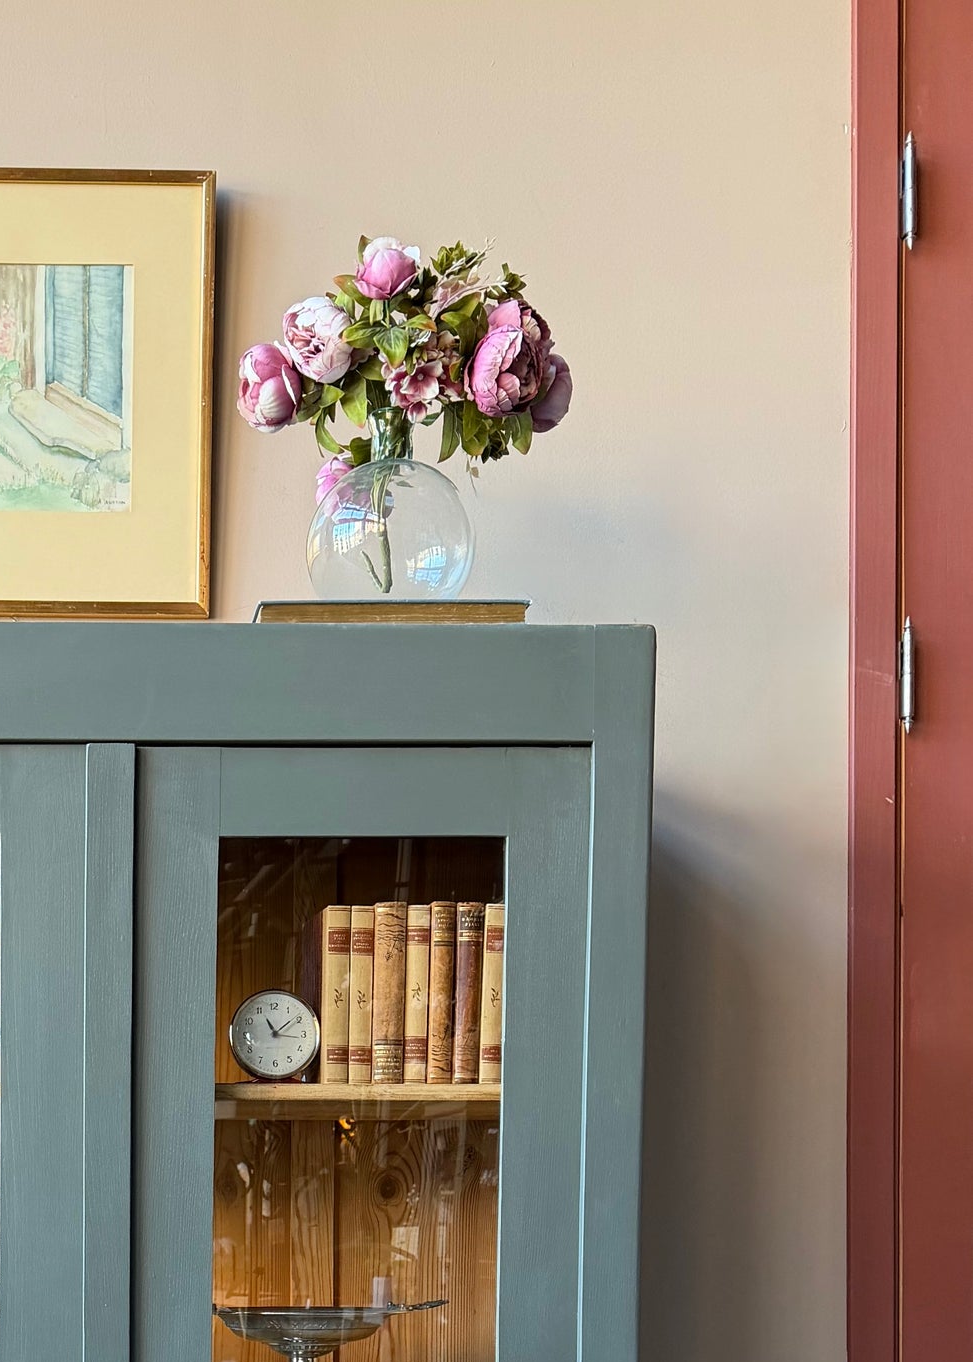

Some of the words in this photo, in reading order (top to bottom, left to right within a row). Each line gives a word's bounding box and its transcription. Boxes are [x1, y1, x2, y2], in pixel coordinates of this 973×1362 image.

[256, 1006, 263, 1014] 11
[269, 1002, 279, 1011] 12
[286, 1006, 290, 1014] 1
[244, 1017, 254, 1025] 10
[296, 1016, 303, 1024] 2
[300, 1030, 307, 1039] 3
[247, 1045, 253, 1053] 8
[297, 1044, 303, 1052] 4
[258, 1056, 264, 1064] 7
[286, 1055, 293, 1063] 5
[272, 1060, 279, 1068] 6
